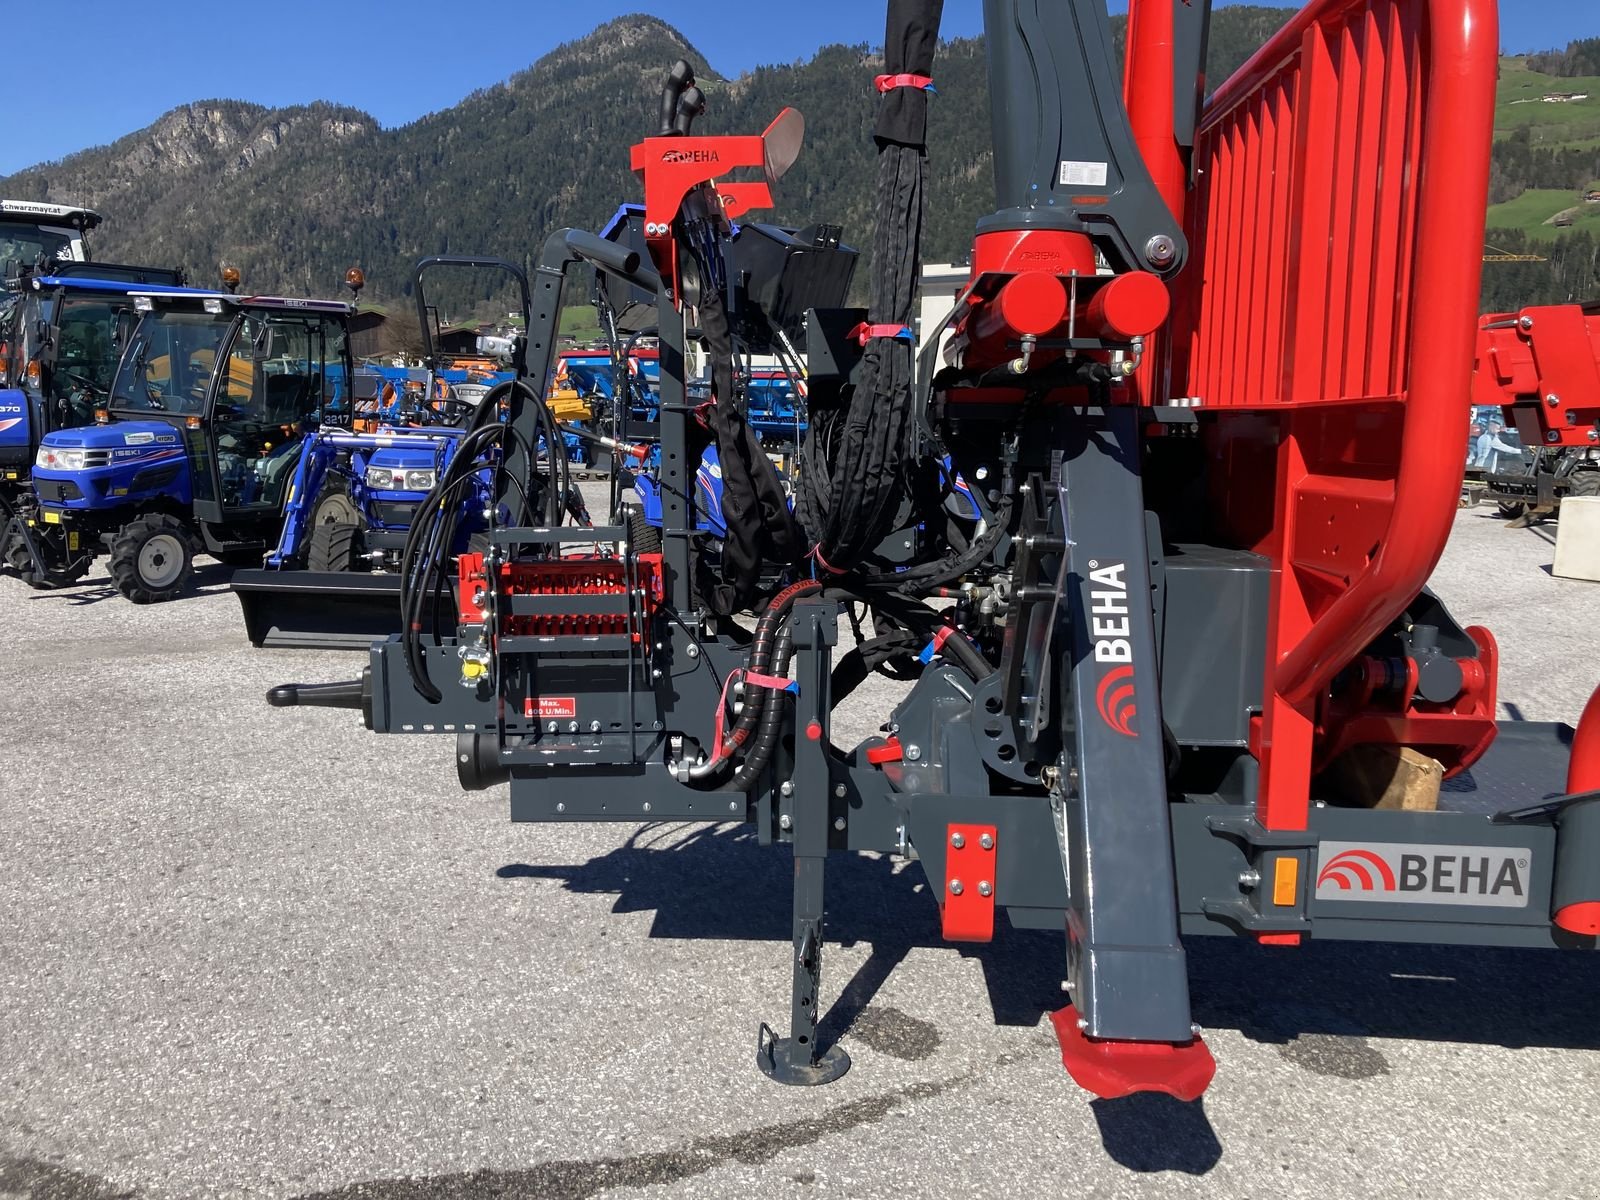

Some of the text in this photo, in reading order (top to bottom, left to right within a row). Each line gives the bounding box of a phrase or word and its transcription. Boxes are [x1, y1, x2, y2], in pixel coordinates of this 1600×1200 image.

[684, 150, 720, 163] BEHA
[284, 299, 308, 308] ISEKI
[324, 414, 350, 425] 3217
[115, 449, 140, 457] ISEKI
